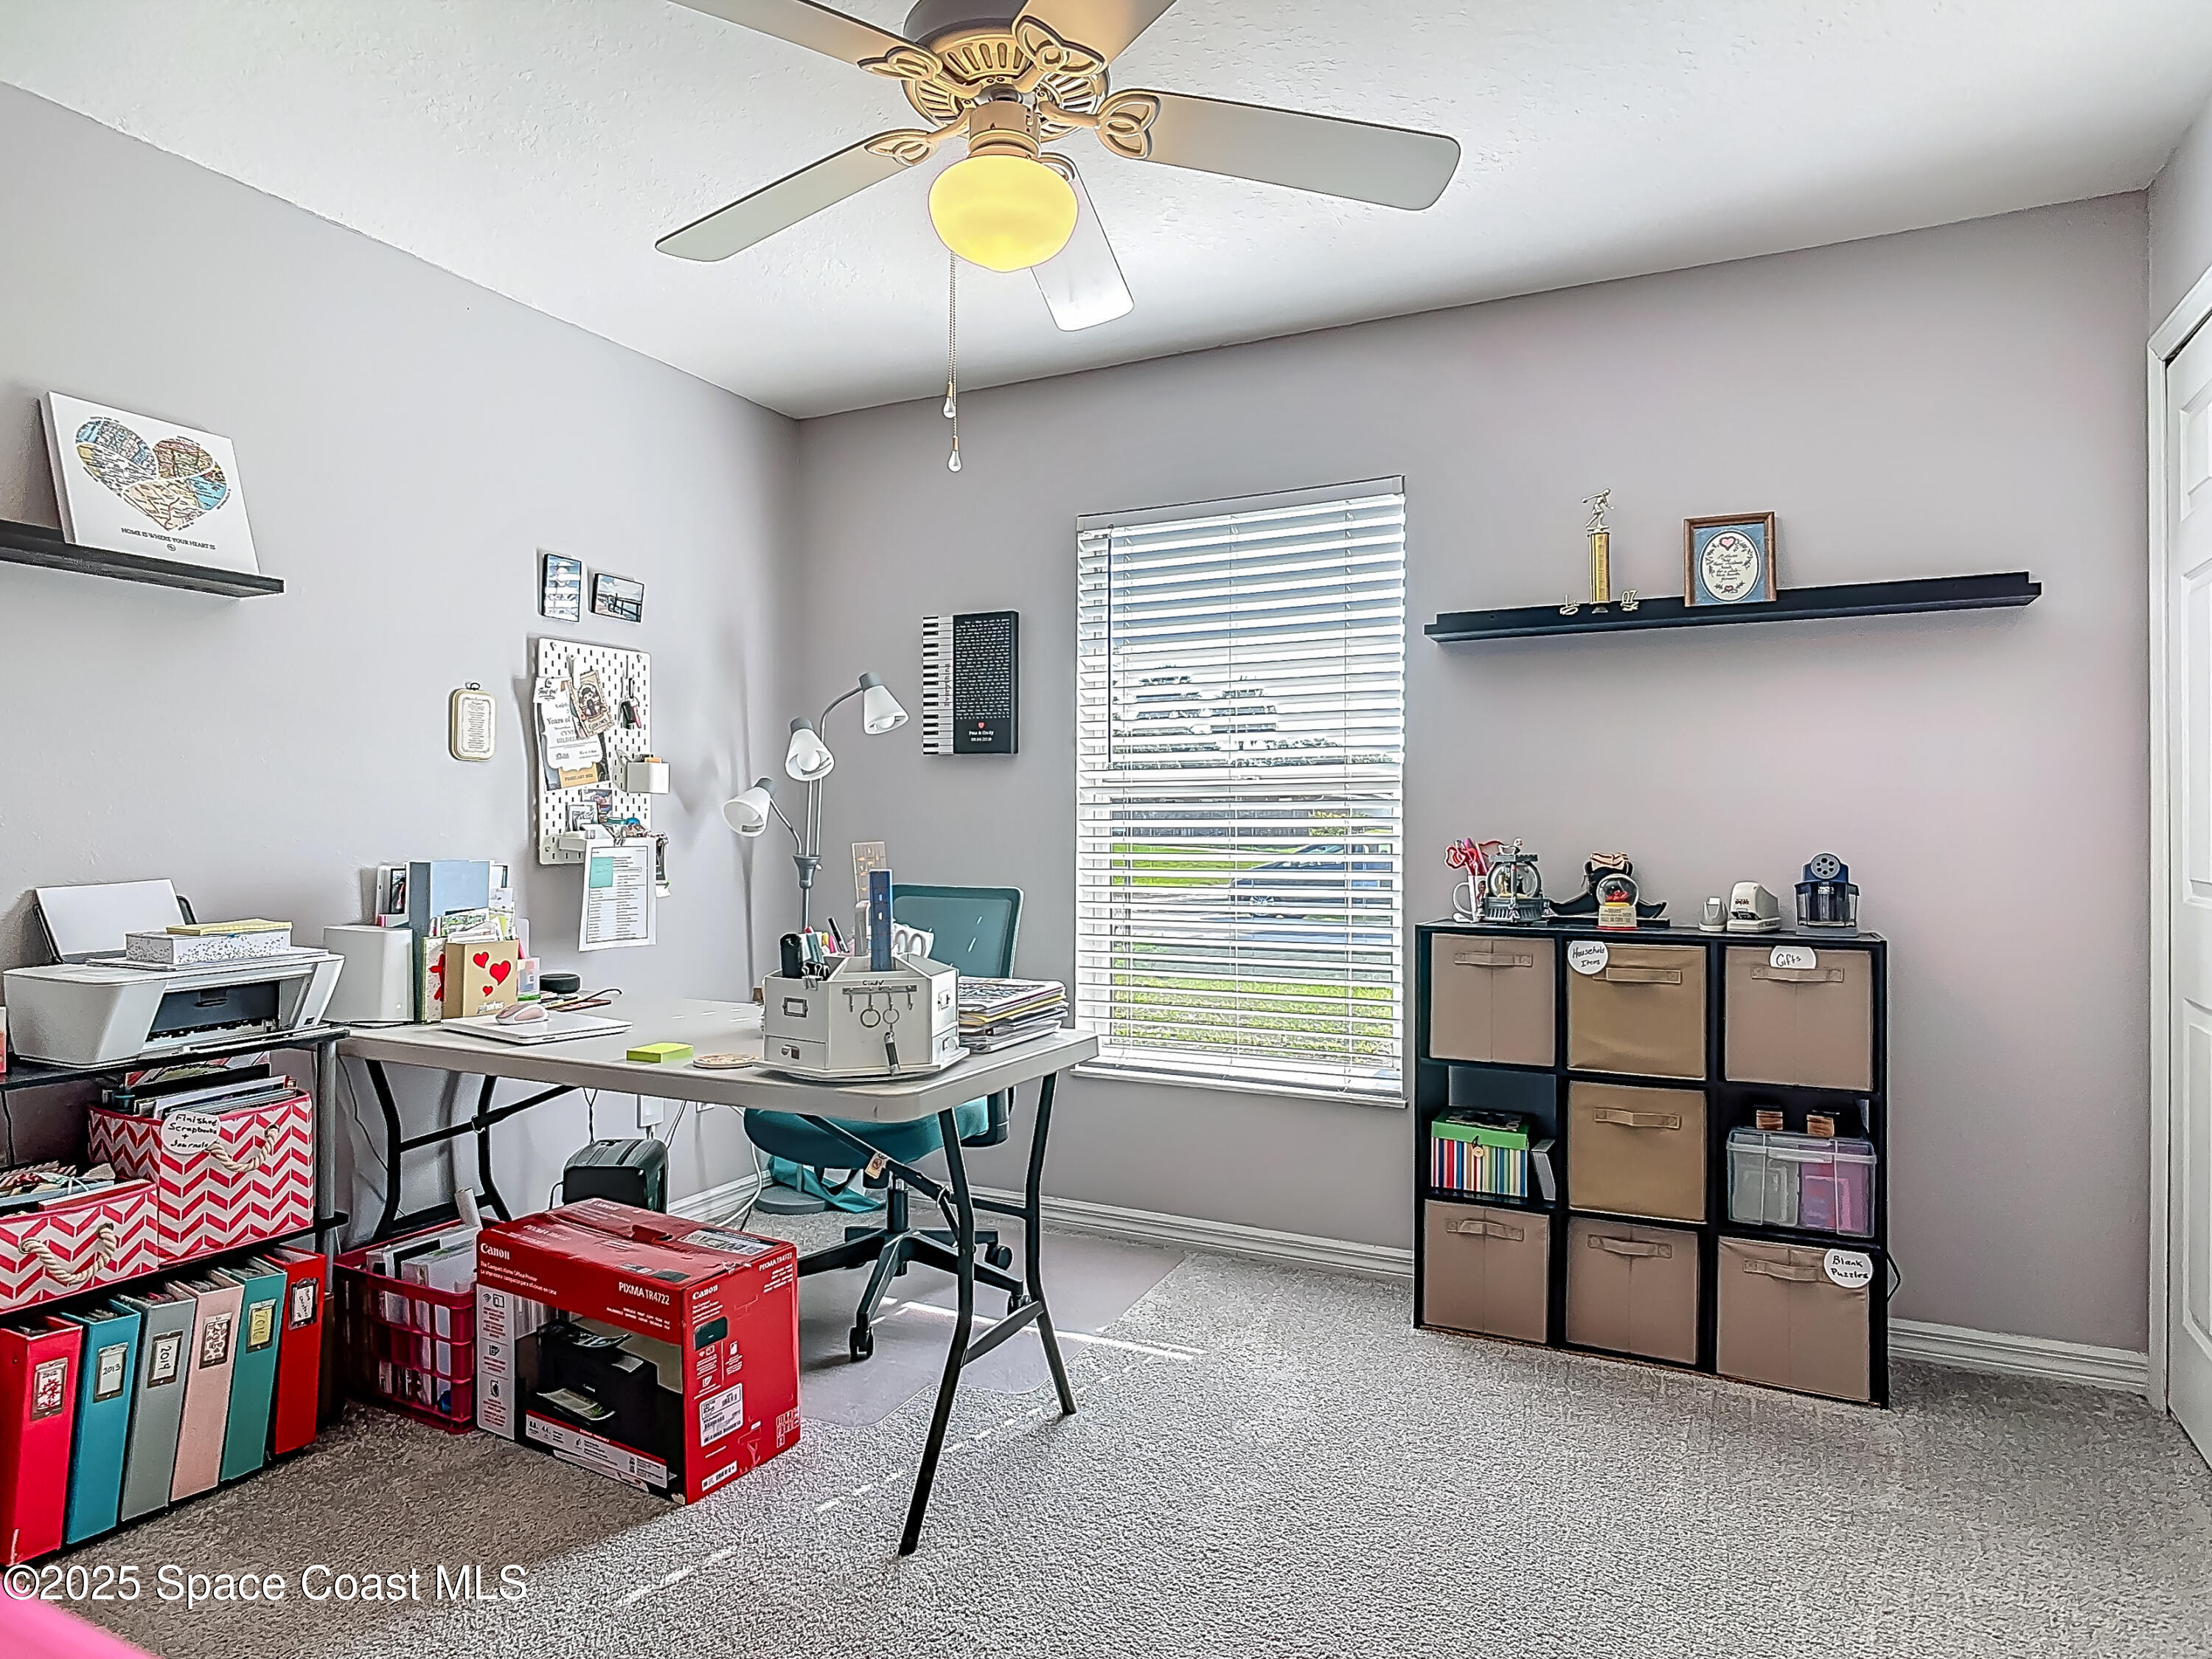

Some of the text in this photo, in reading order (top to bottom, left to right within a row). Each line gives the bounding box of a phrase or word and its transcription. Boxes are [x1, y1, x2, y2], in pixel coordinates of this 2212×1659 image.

[148, 532, 171, 542] WHERE
[171, 537, 189, 546] YOUR
[1572, 946, 1605, 959] Household
[1775, 953, 1801, 967] Gifts
[175, 1113, 218, 1127] Finished
[480, 1242, 510, 1260] Canon
[1832, 1255, 1863, 1267] Blank
[1830, 1267, 1868, 1279] Puzzles
[619, 1281, 669, 1305] PIXMA TR4722
[692, 1284, 718, 1300] Canon
[159, 1346, 172, 1370] 2014
[102, 1363, 121, 1375] 2013
